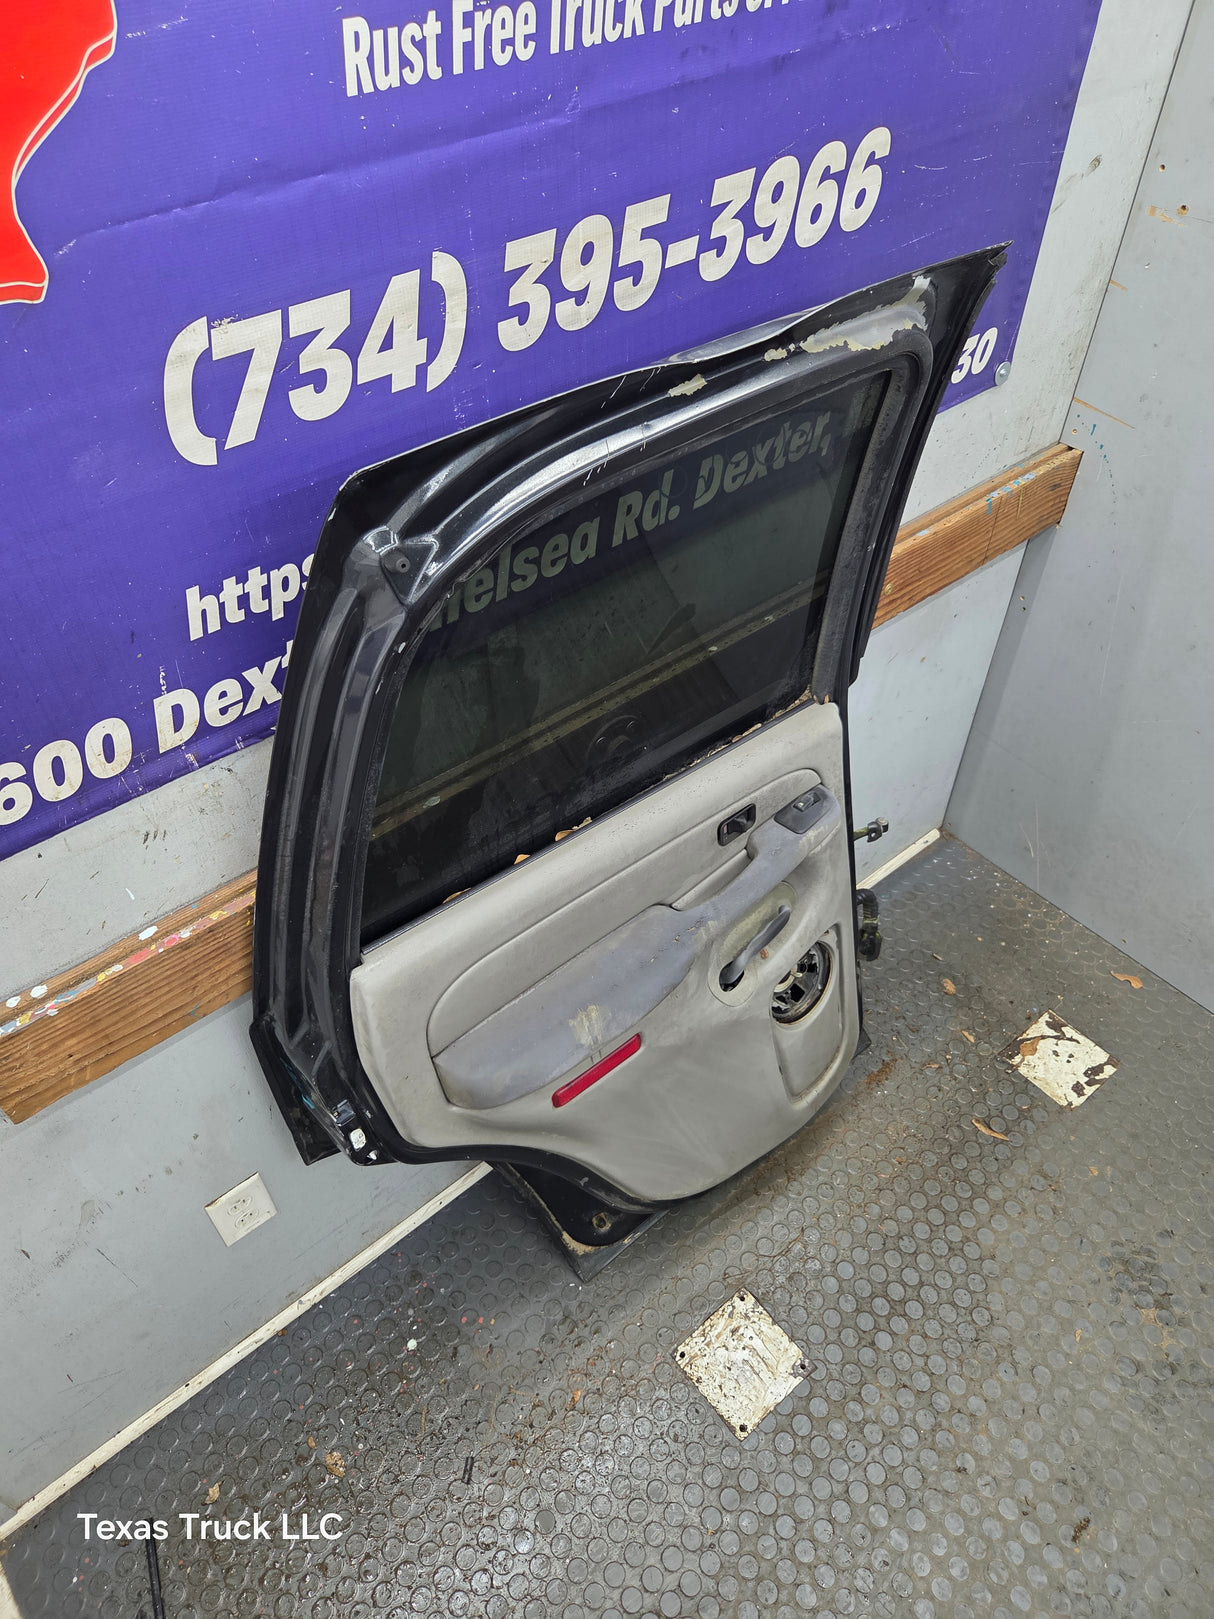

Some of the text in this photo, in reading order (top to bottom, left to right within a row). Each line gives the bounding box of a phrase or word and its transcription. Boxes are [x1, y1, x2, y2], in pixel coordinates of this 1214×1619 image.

[342, 10, 443, 97] Rust
[452, 0, 537, 75] Free
[549, 0, 646, 55] Truck
[163, 126, 892, 466] (734) 395-3966
[0, 717, 133, 826] 600
[611, 467, 681, 548] Rd.
[693, 411, 831, 508] Dexter,
